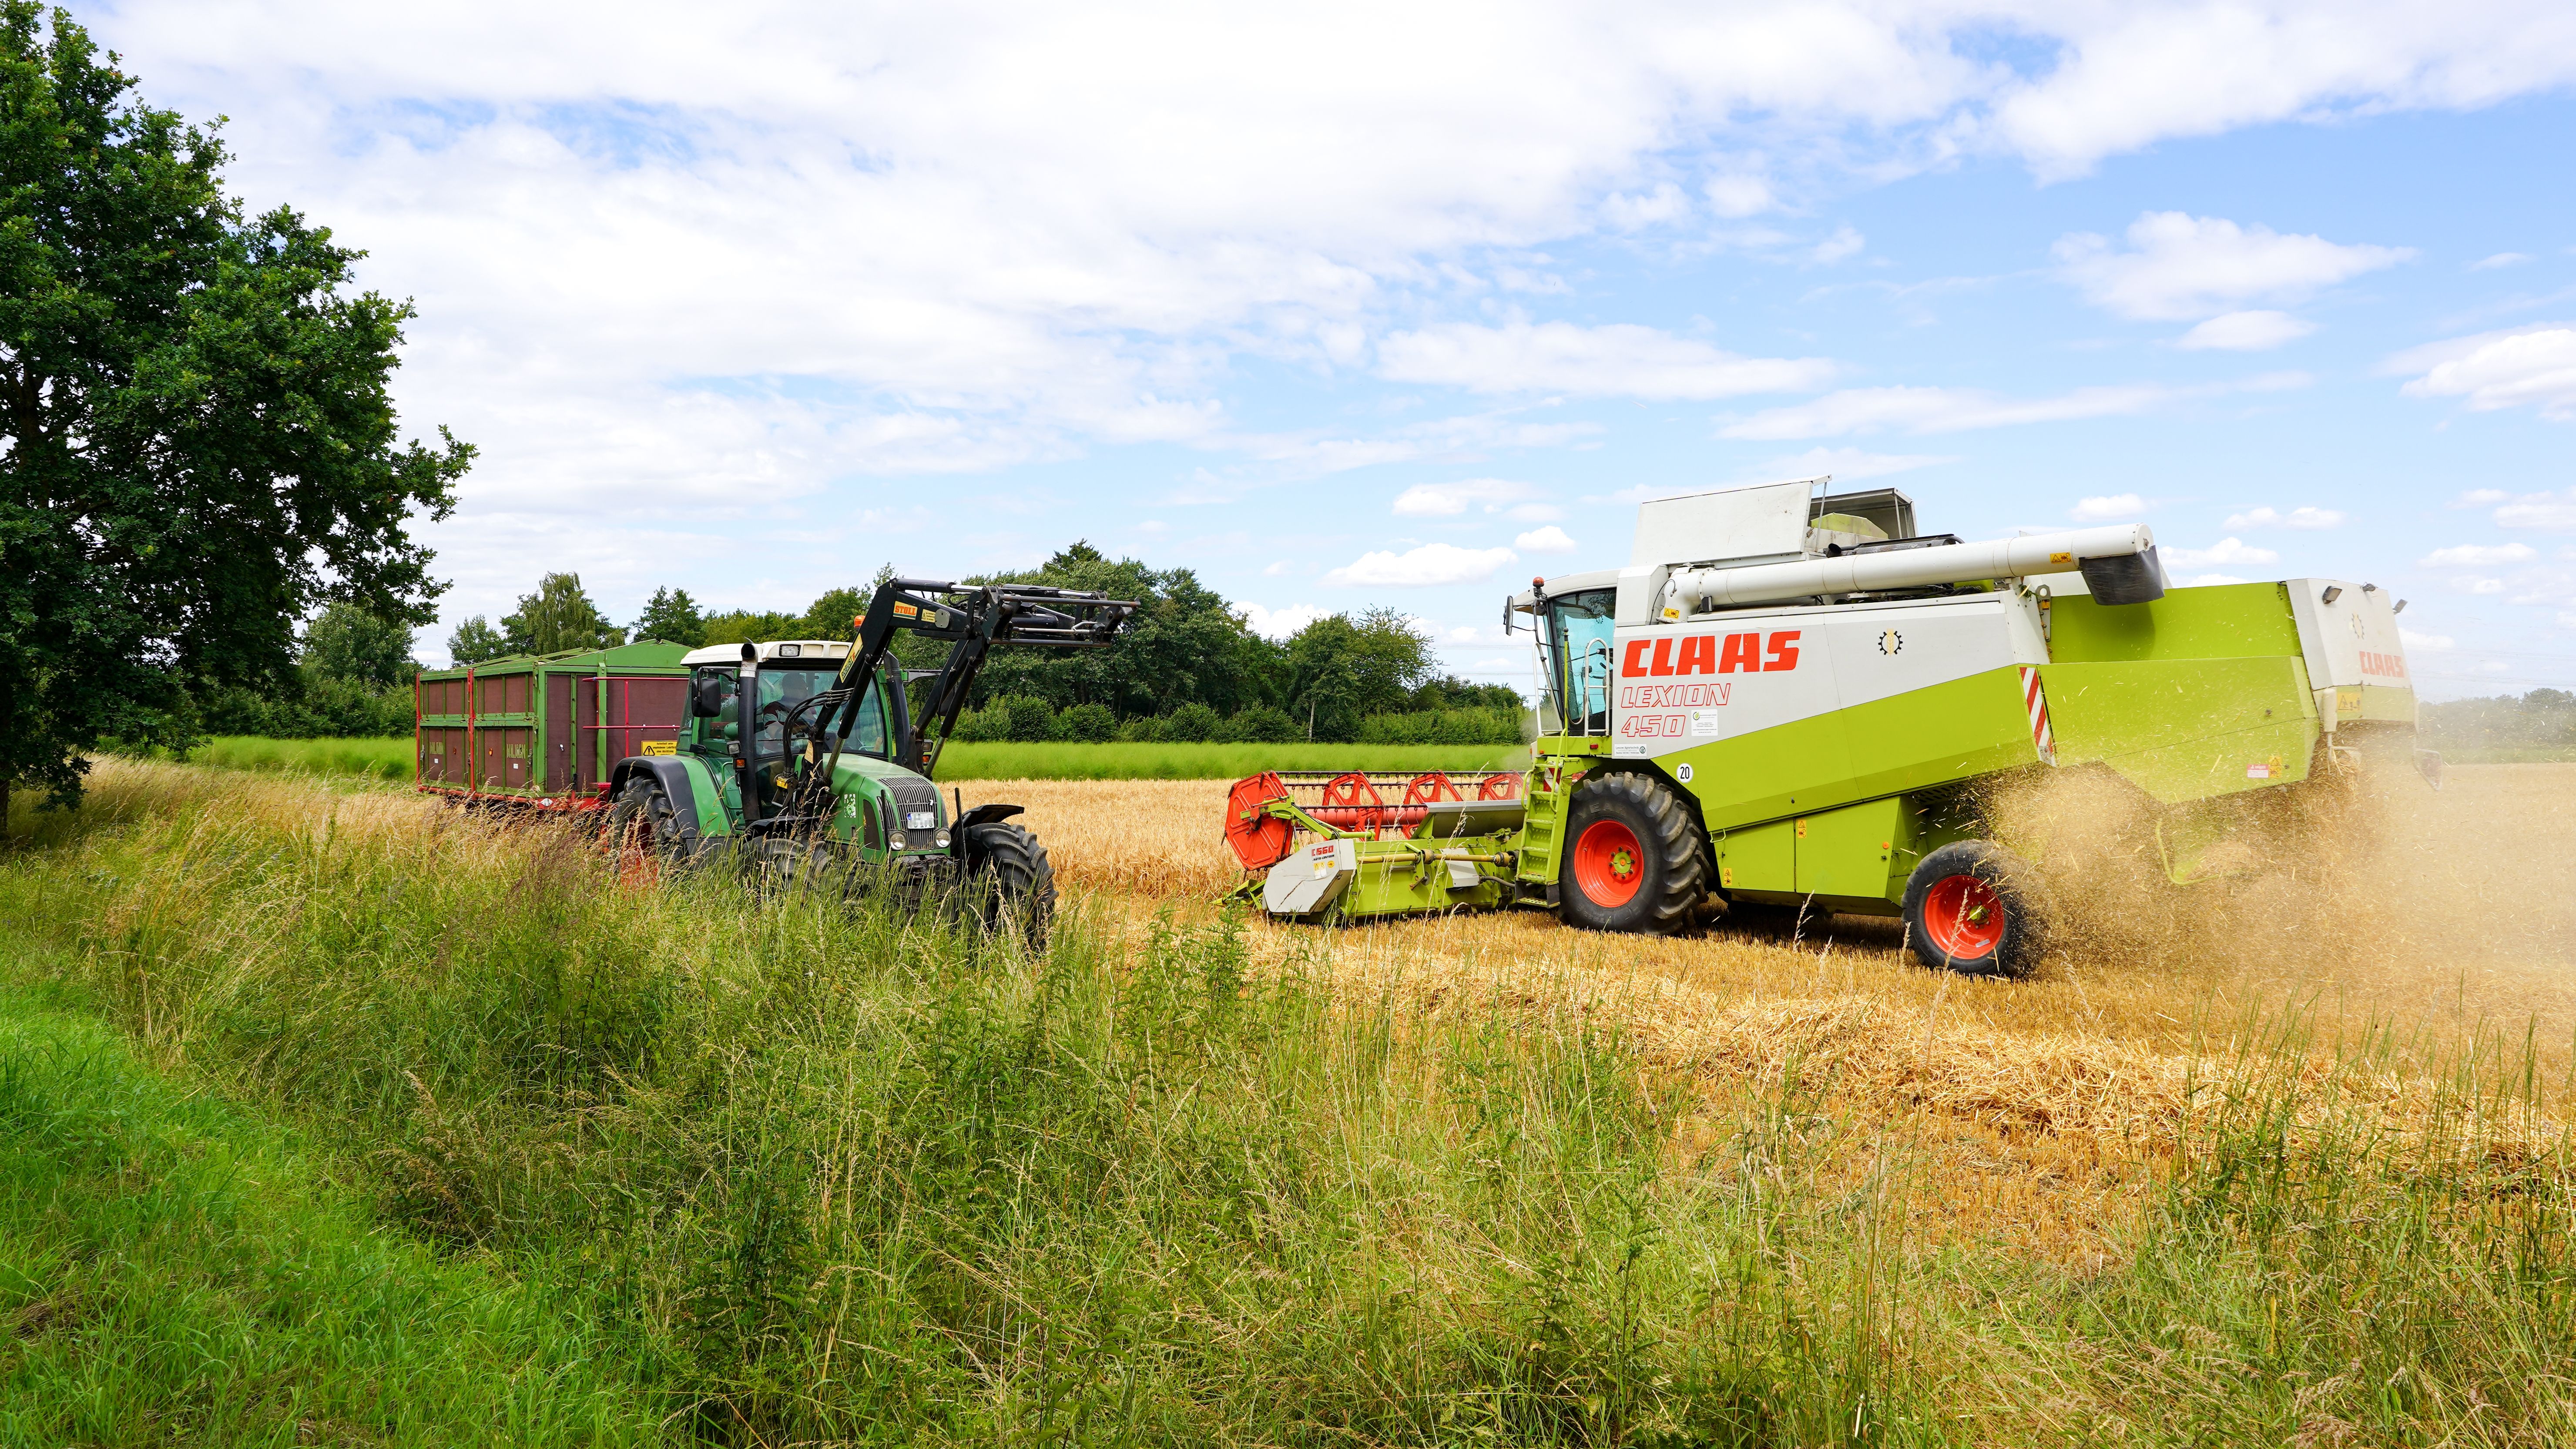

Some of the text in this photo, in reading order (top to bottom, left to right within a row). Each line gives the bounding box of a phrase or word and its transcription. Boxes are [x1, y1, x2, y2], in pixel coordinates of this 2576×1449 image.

[895, 605, 916, 615] STOLL
[1622, 631, 1801, 678] CLAAS
[2359, 651, 2405, 678] CLAAS
[841, 655, 853, 678] ROBUST
[1621, 683, 1731, 708] LEXION
[1621, 715, 1686, 737] 450
[1680, 766, 1690, 779] 20
